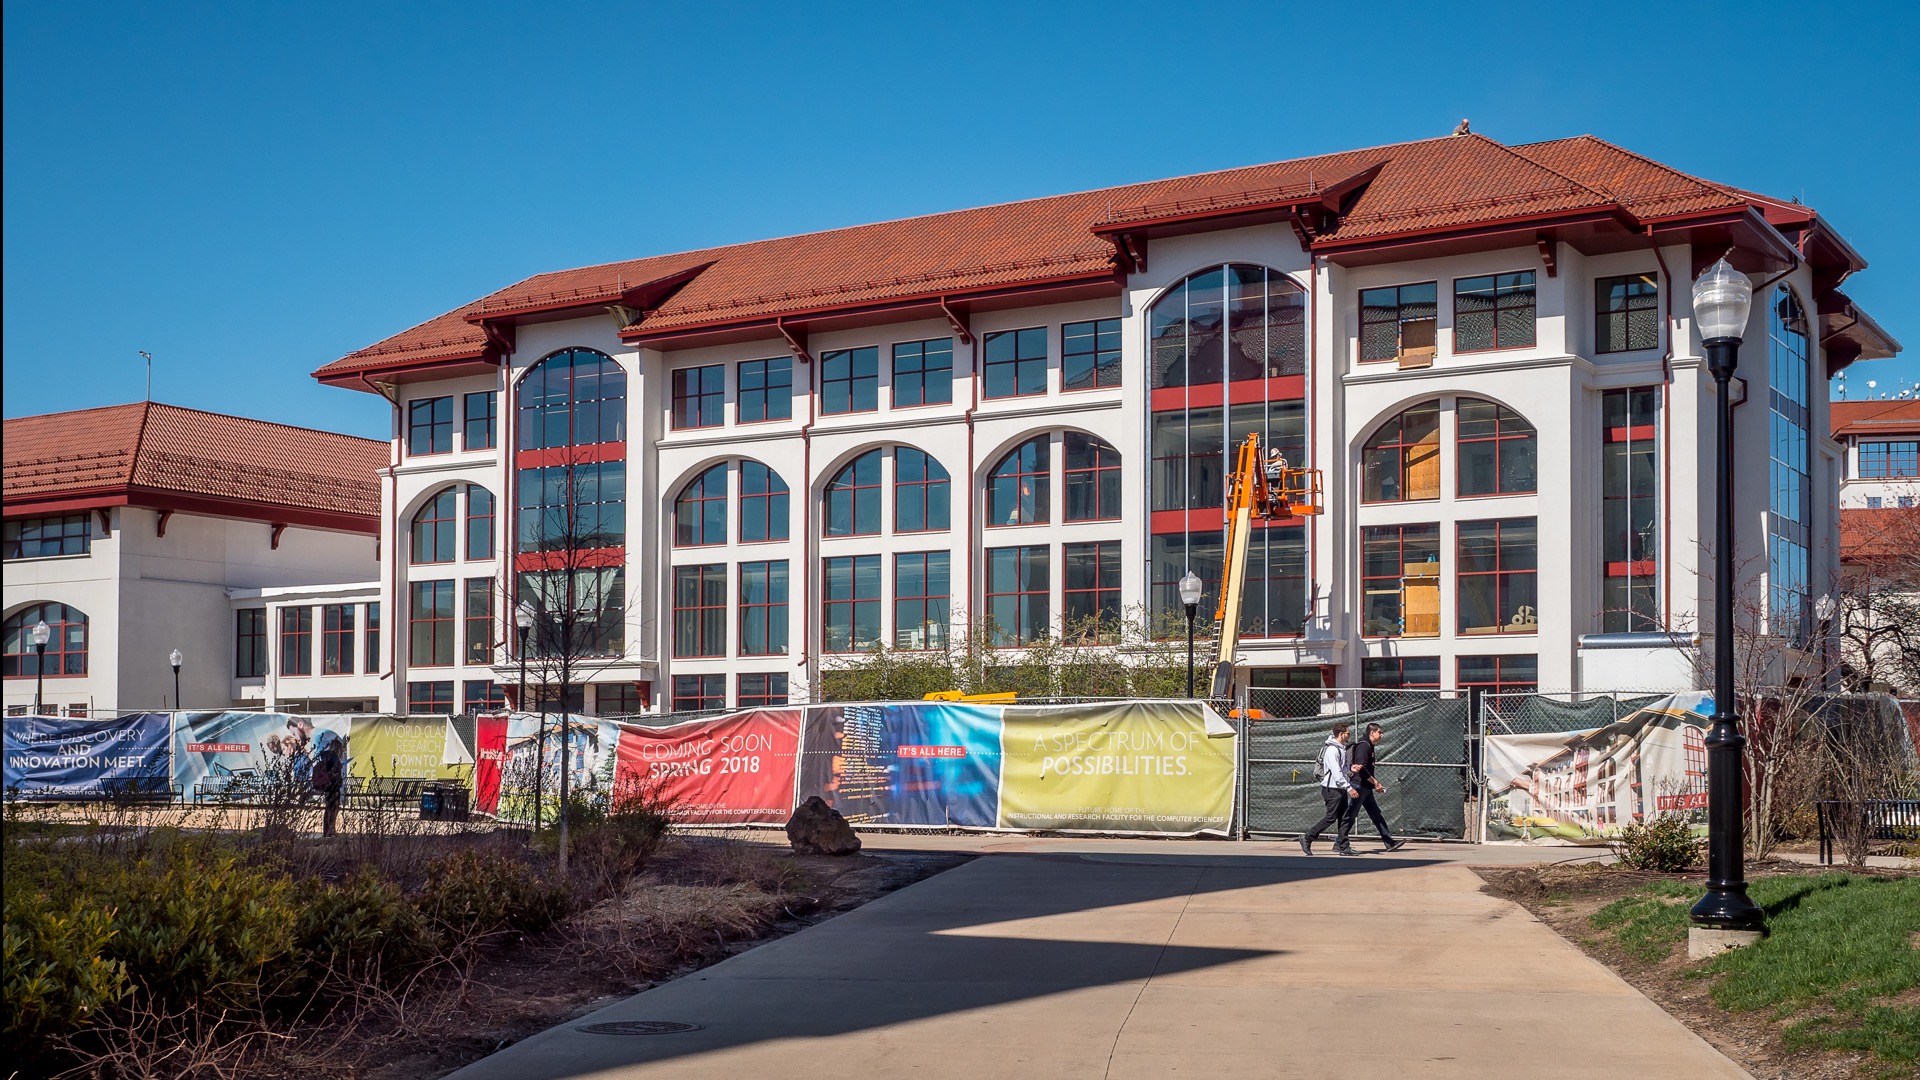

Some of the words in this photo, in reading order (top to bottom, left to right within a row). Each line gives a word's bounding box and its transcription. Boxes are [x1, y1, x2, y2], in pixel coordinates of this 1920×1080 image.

[13, 732, 57, 743] WHERE
[61, 729, 146, 743] DISCOVERY
[1033, 734, 1048, 752] A
[1052, 731, 1163, 752] SPECTRUM
[1170, 731, 1199, 751] OF
[57, 744, 91, 756] AND
[224, 744, 249, 752] HERE.
[643, 739, 714, 760] COMING
[720, 734, 772, 753] SOON
[899, 747, 917, 756] IT'S
[919, 747, 936, 756] ALL
[937, 747, 965, 756] HERE.
[10, 756, 100, 769] INNOVATION
[104, 755, 147, 769] MEET.
[391, 754, 422, 767] DOWN
[424, 755, 437, 767] TO
[650, 758, 713, 779] SPRING
[720, 755, 760, 774] 2018
[1041, 755, 1192, 776] POSSIBILITIES.
[1660, 797, 1685, 807] IT'S
